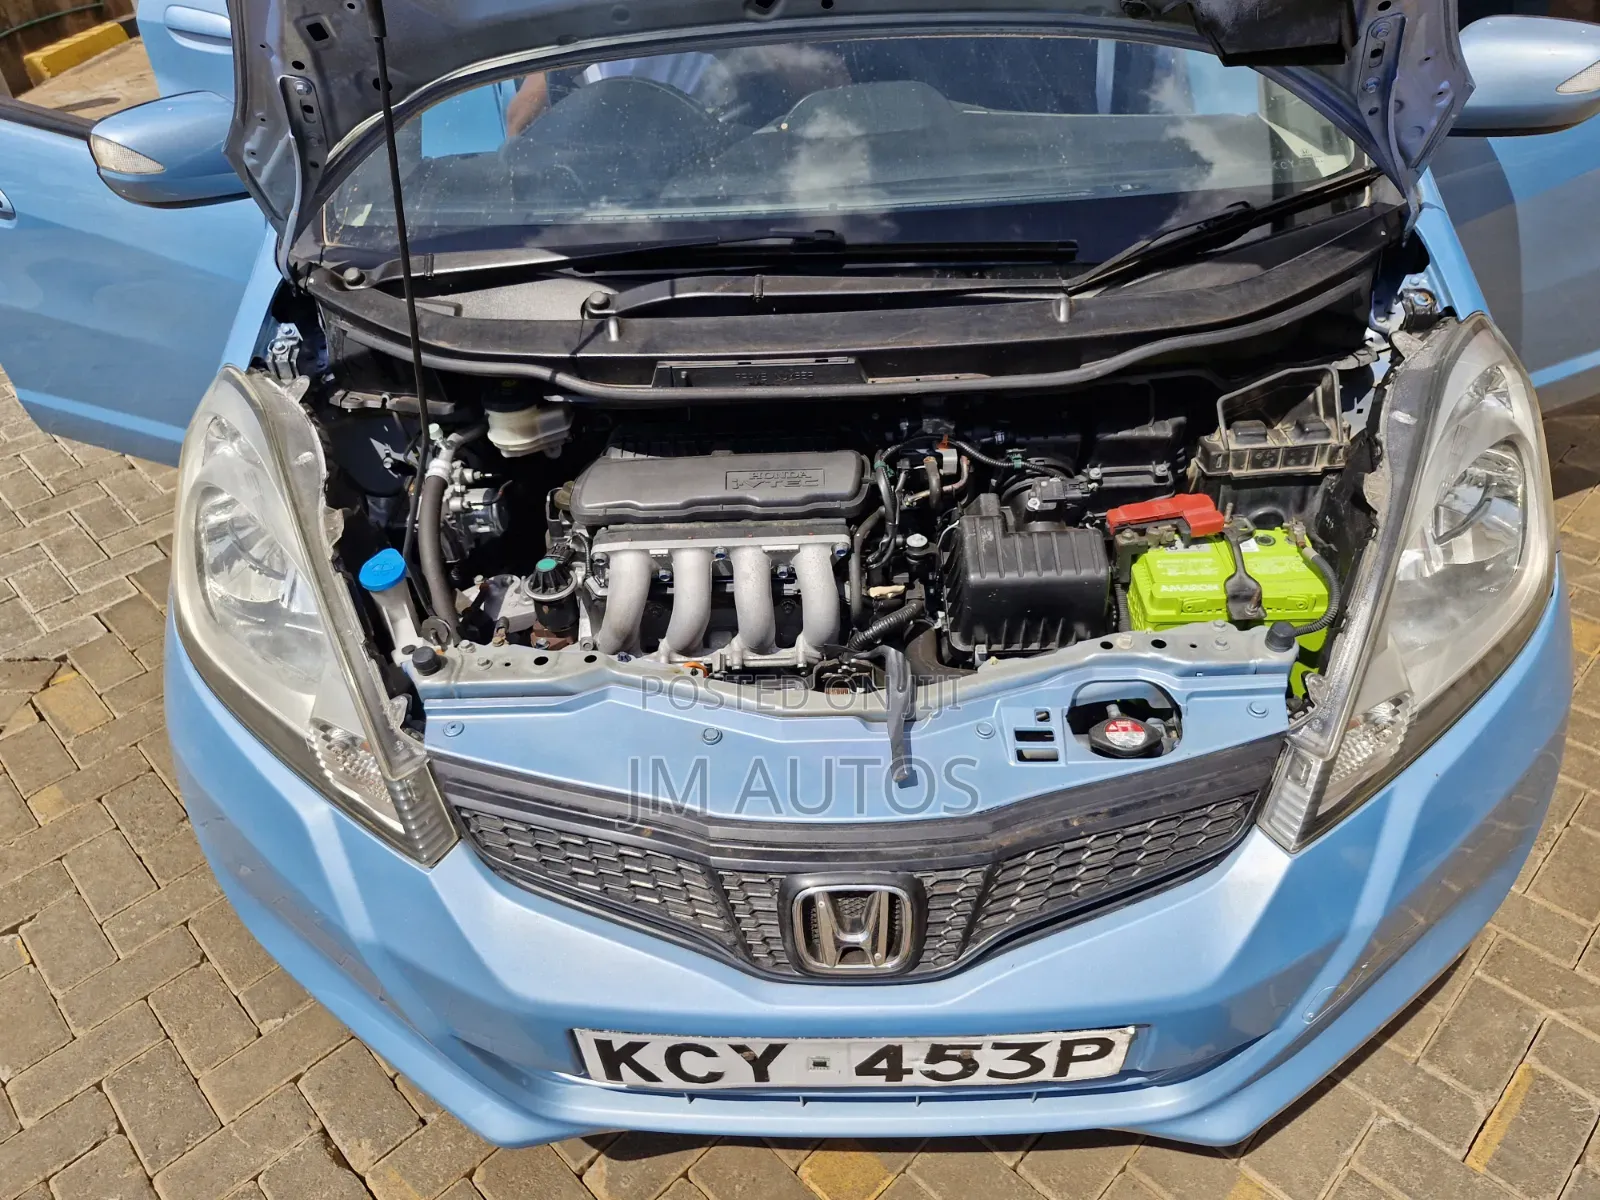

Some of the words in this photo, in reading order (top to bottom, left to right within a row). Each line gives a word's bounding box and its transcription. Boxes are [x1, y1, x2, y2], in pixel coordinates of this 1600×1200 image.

[749, 471, 812, 479] HONDA
[594, 1038, 788, 1084] KCY
[854, 1037, 1116, 1082] 453P
